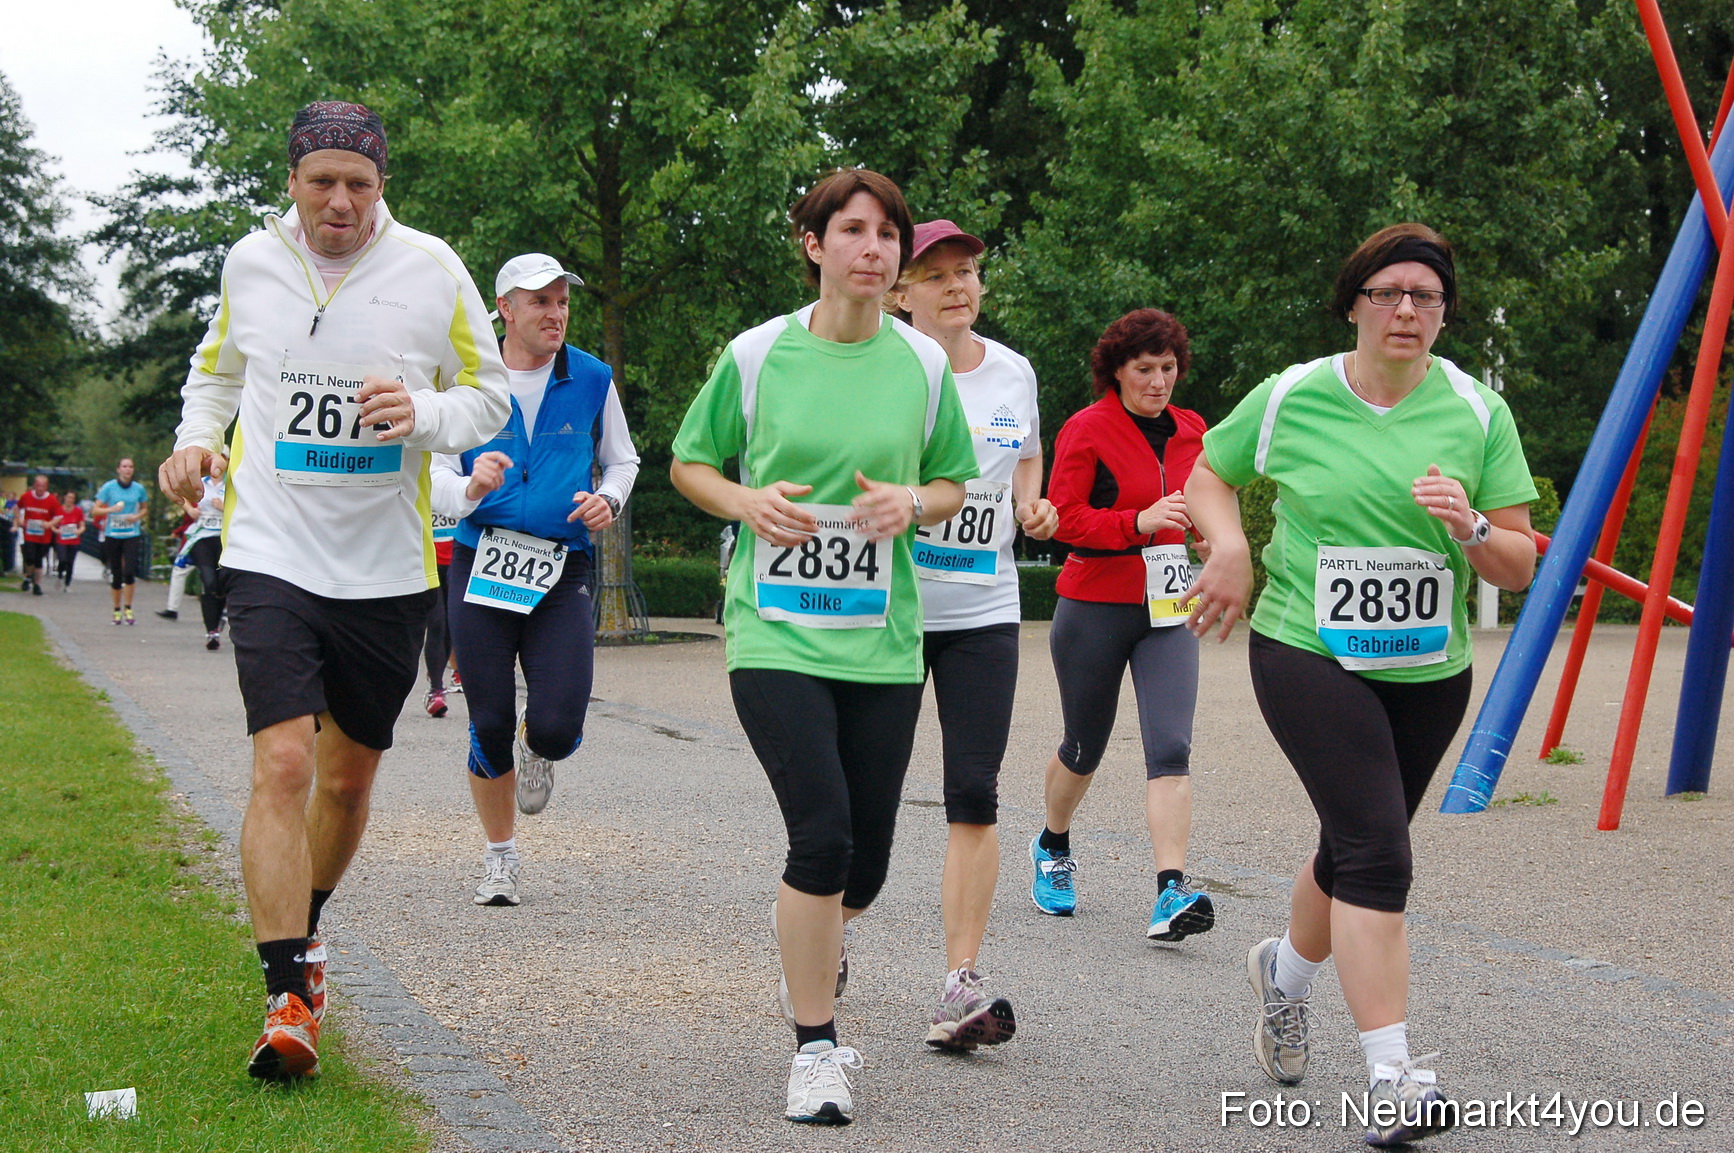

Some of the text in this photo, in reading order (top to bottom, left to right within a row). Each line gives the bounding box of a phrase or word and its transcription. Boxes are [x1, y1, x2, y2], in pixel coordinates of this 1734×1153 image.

[280, 372, 324, 386] PARTL
[288, 391, 393, 440] 267
[306, 450, 374, 473] Rüdiger
[814, 518, 869, 530] eumarkt
[482, 534, 551, 558] PARTL Neumarkt
[769, 535, 879, 582] 2834
[1145, 553, 1171, 562] PARTL
[1319, 558, 1429, 571] PARTL Neumarkt
[482, 547, 554, 590] 2842
[489, 585, 535, 604] Michael
[800, 592, 842, 611] Silke
[1330, 577, 1439, 623] 2830
[1347, 635, 1420, 653] Gabriele
